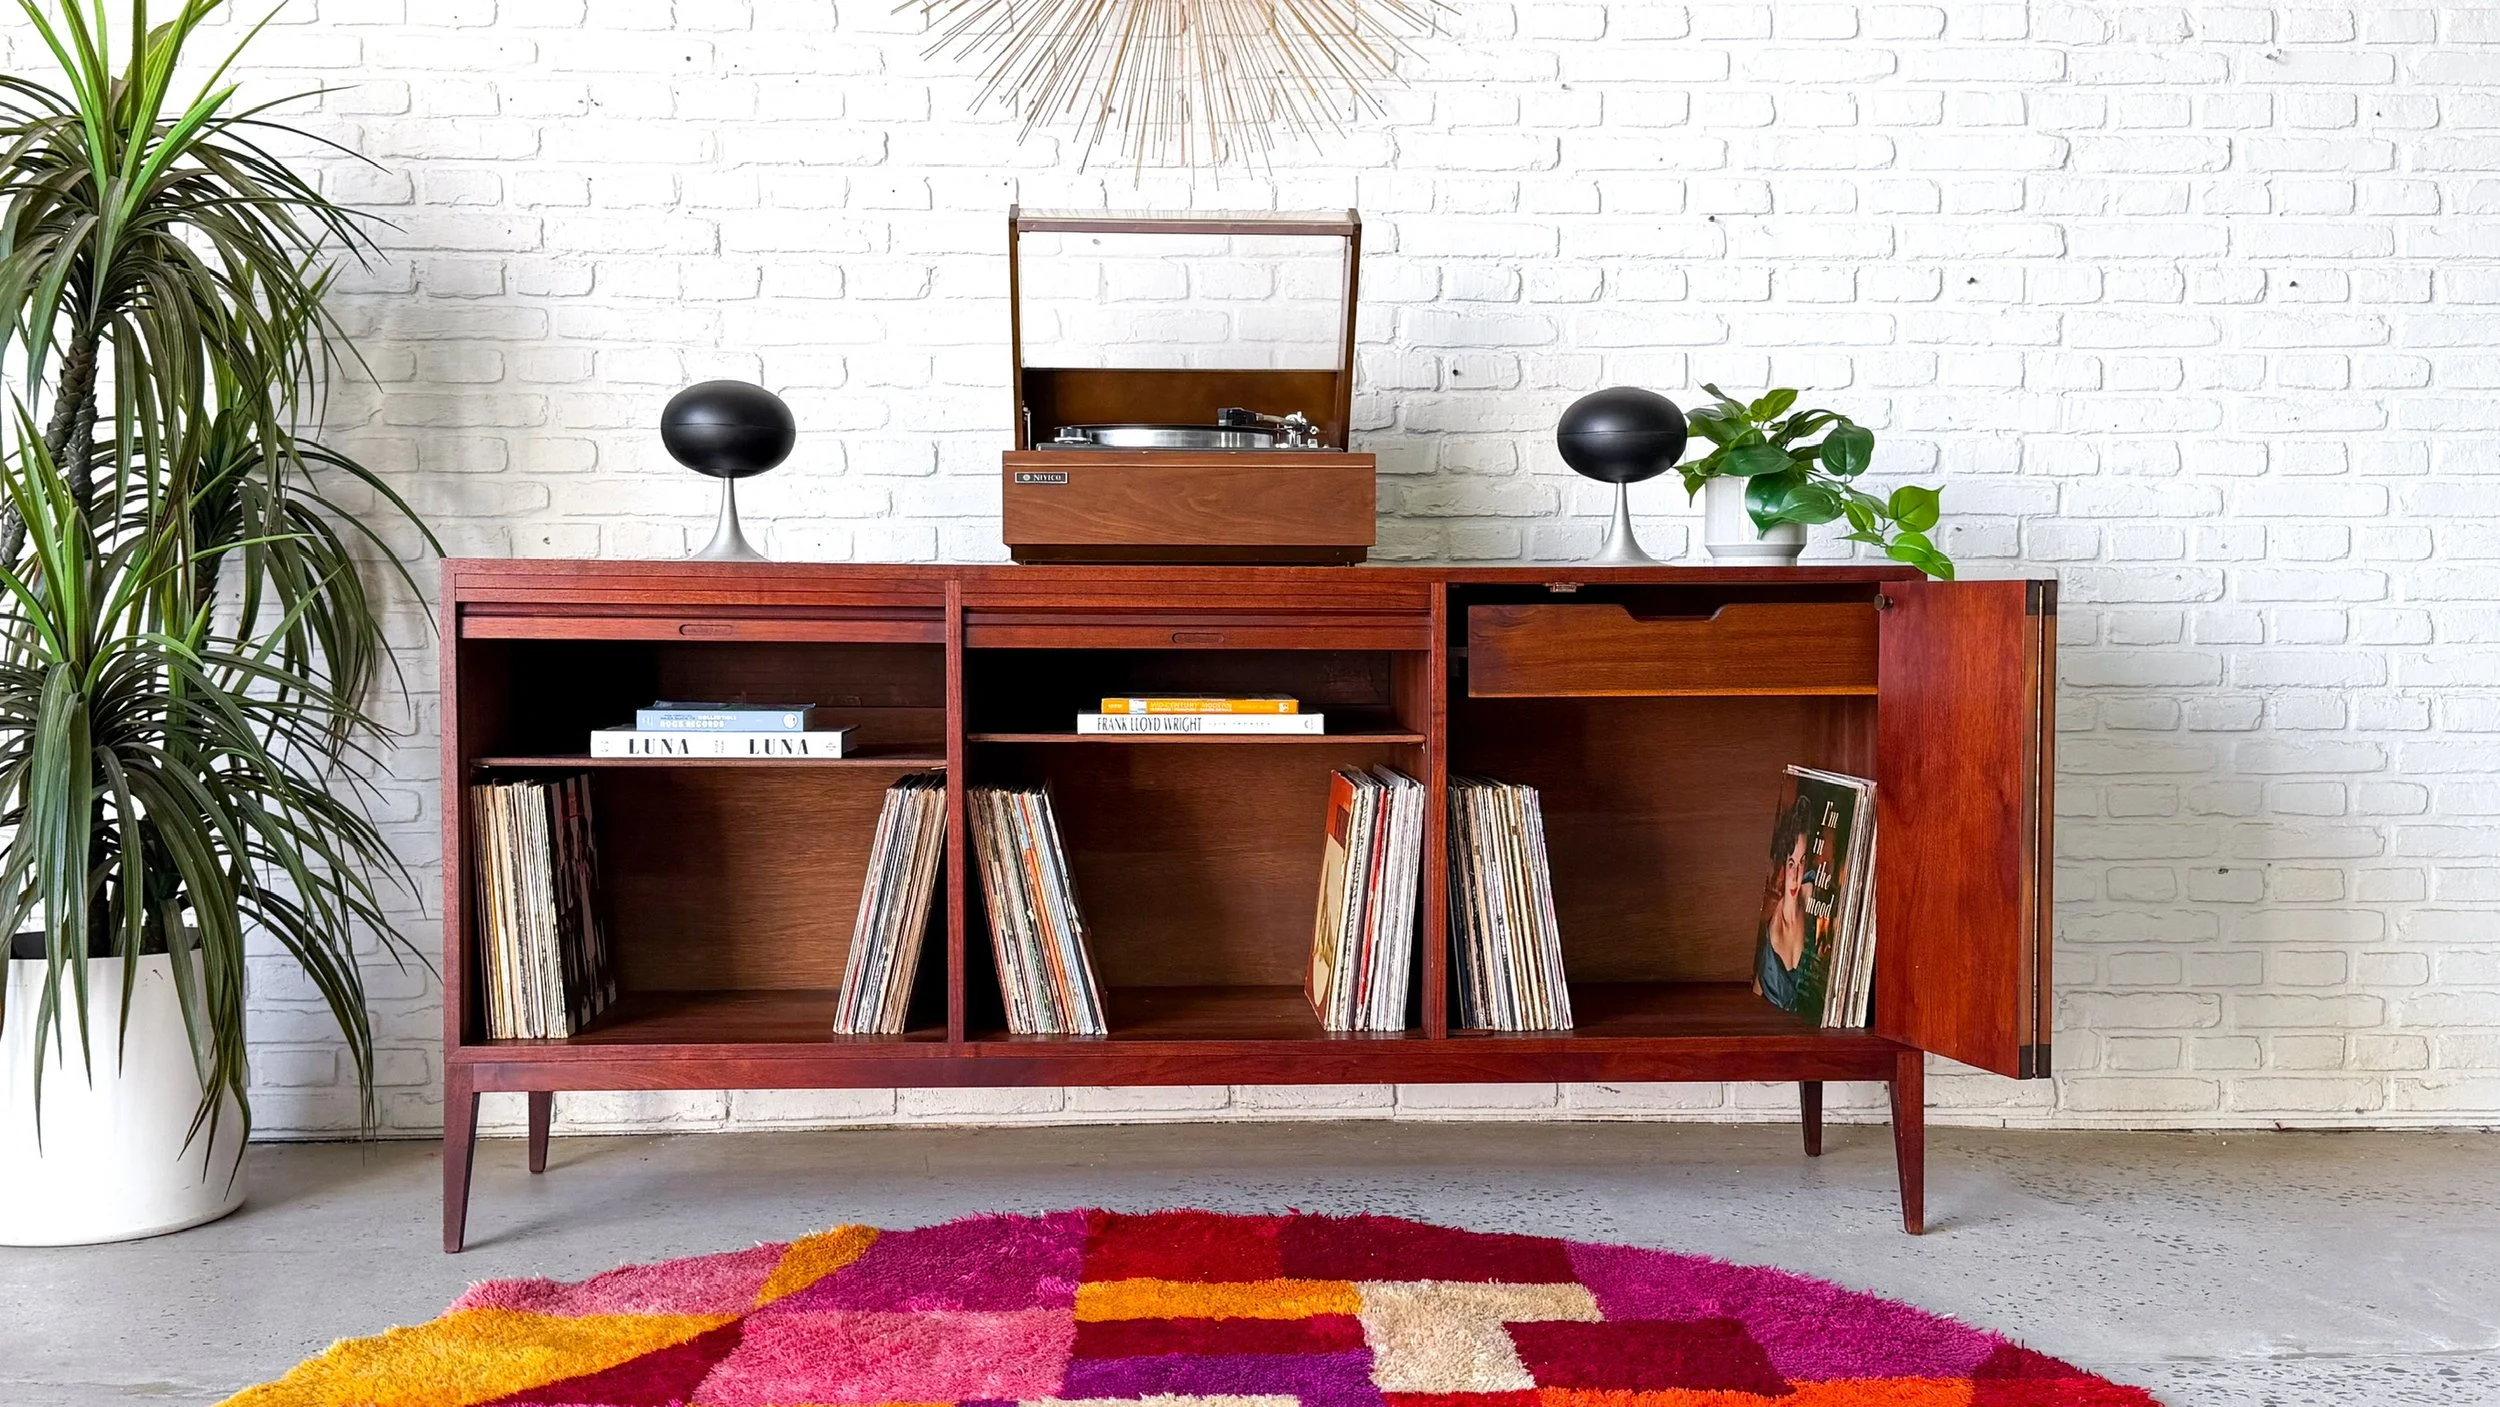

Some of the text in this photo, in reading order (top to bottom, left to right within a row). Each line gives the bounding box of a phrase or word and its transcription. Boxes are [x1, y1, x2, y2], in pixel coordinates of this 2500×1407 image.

[1097, 717, 1202, 732] FRANK LLOYD WRIGHT
[628, 738, 690, 755] LUNA
[749, 738, 809, 755] LUNA
[1820, 800, 1839, 829] I'm
[1812, 831, 1825, 856] in
[1814, 861, 1832, 891] the
[1805, 894, 1835, 919] mood
